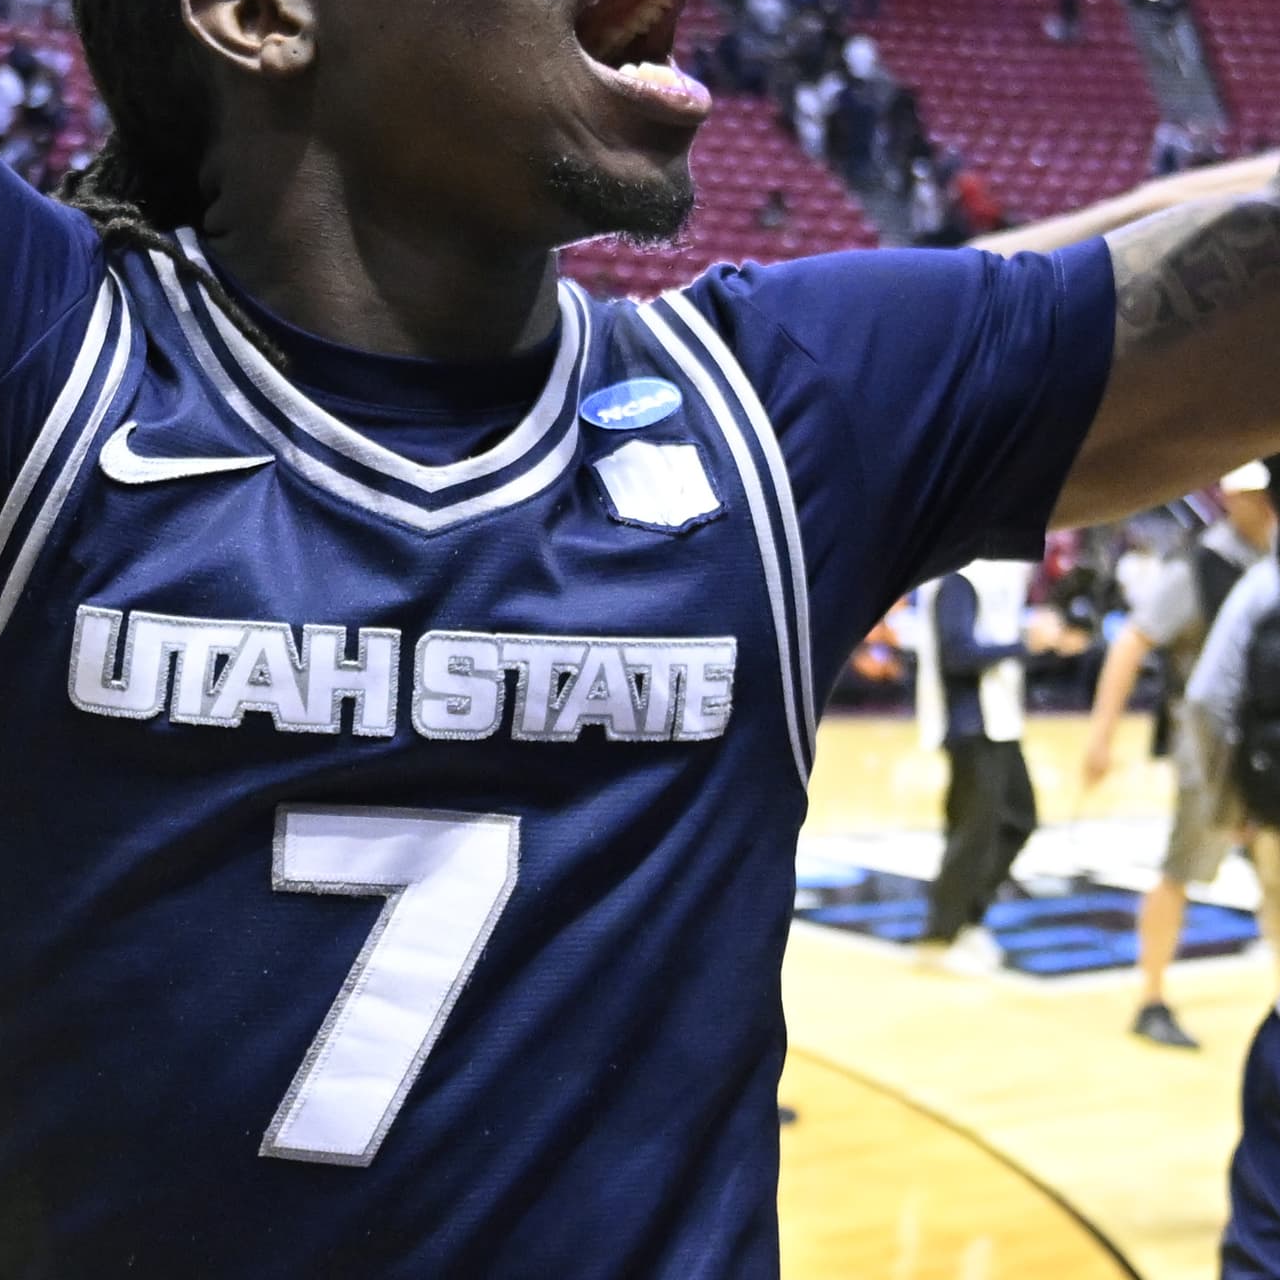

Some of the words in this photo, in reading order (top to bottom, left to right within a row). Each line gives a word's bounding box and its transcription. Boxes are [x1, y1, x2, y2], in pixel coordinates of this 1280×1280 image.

[67, 603, 403, 738] UTAH
[411, 629, 738, 743] STATE
[258, 803, 521, 1168] 7
